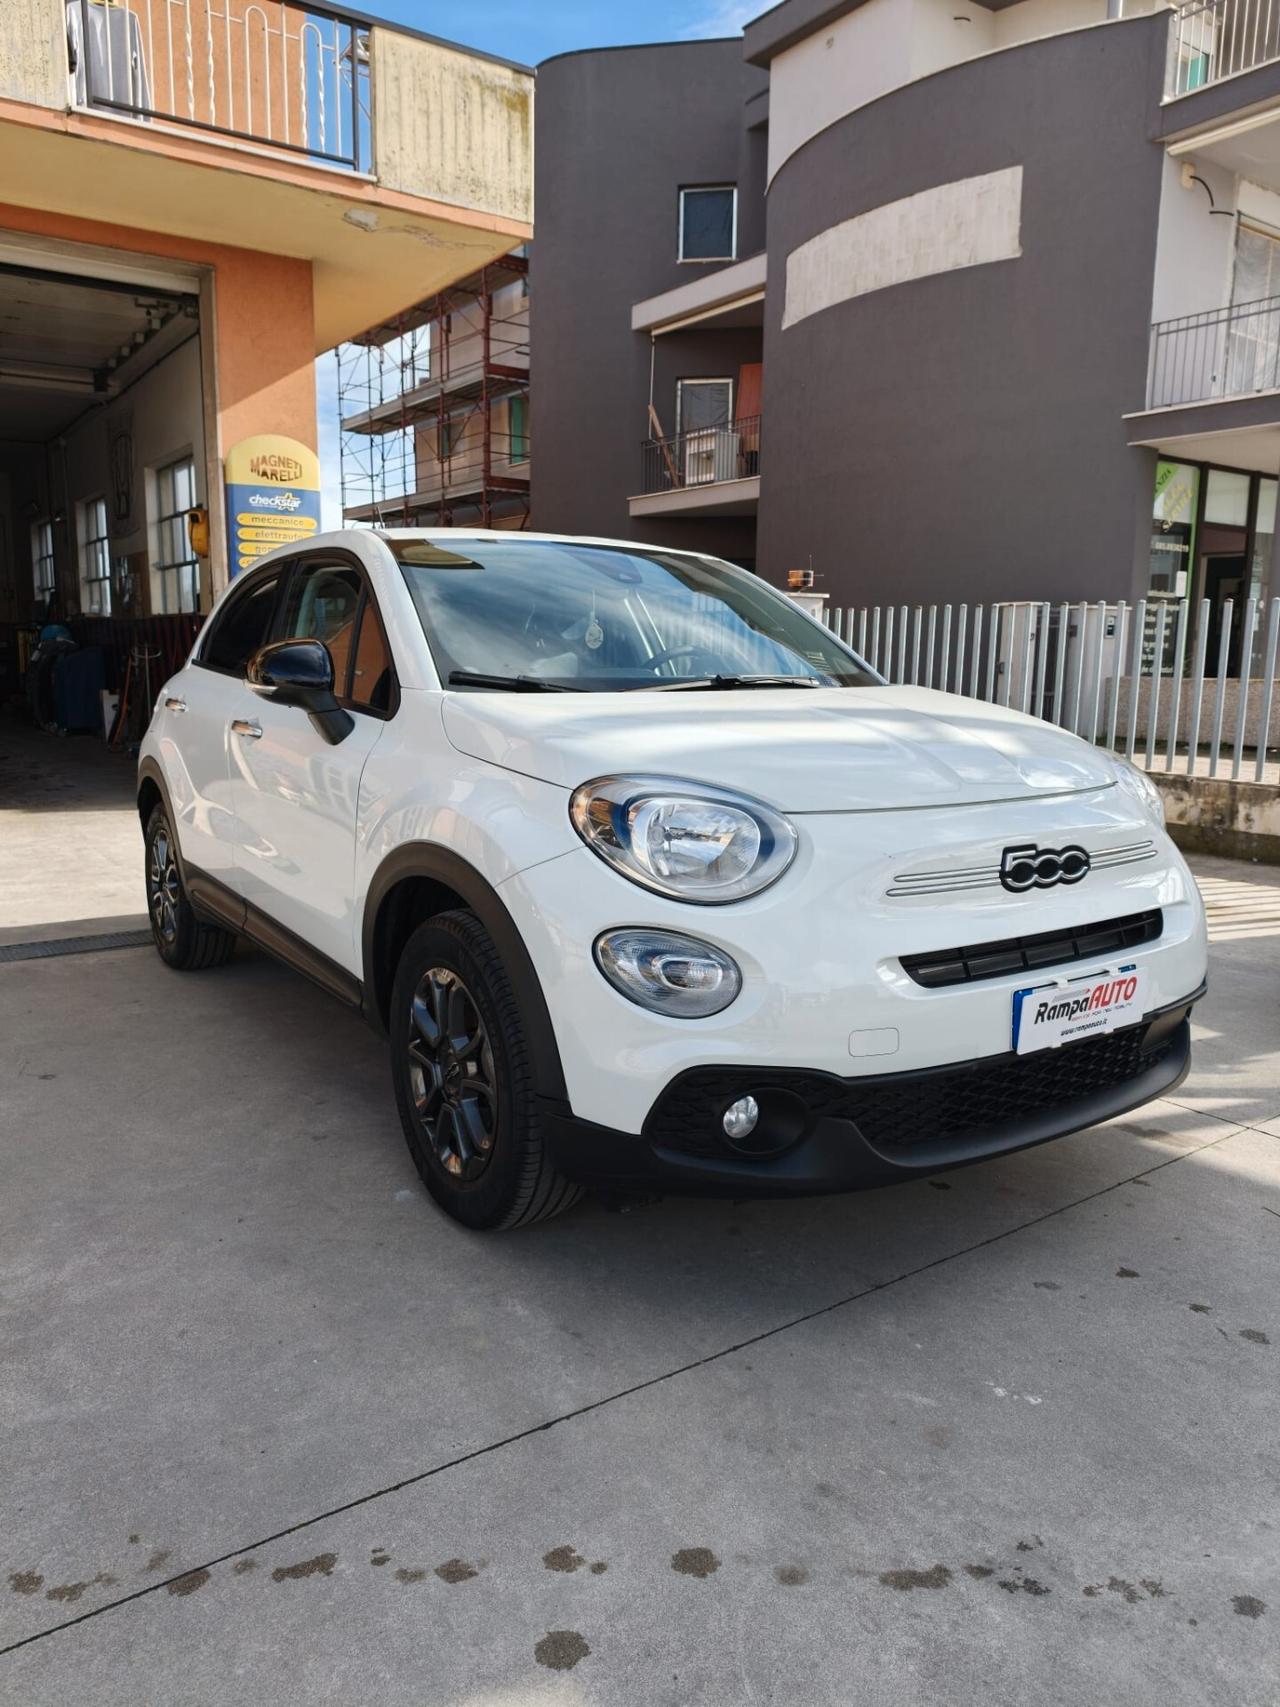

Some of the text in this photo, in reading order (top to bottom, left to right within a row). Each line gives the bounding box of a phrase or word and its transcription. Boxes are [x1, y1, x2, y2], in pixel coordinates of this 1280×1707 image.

[250, 454, 302, 471] MAGNETI
[250, 467, 302, 482] MARELLI
[249, 494, 302, 508] checkstar
[251, 515, 304, 526] meccanico
[1001, 845, 1090, 892] 500
